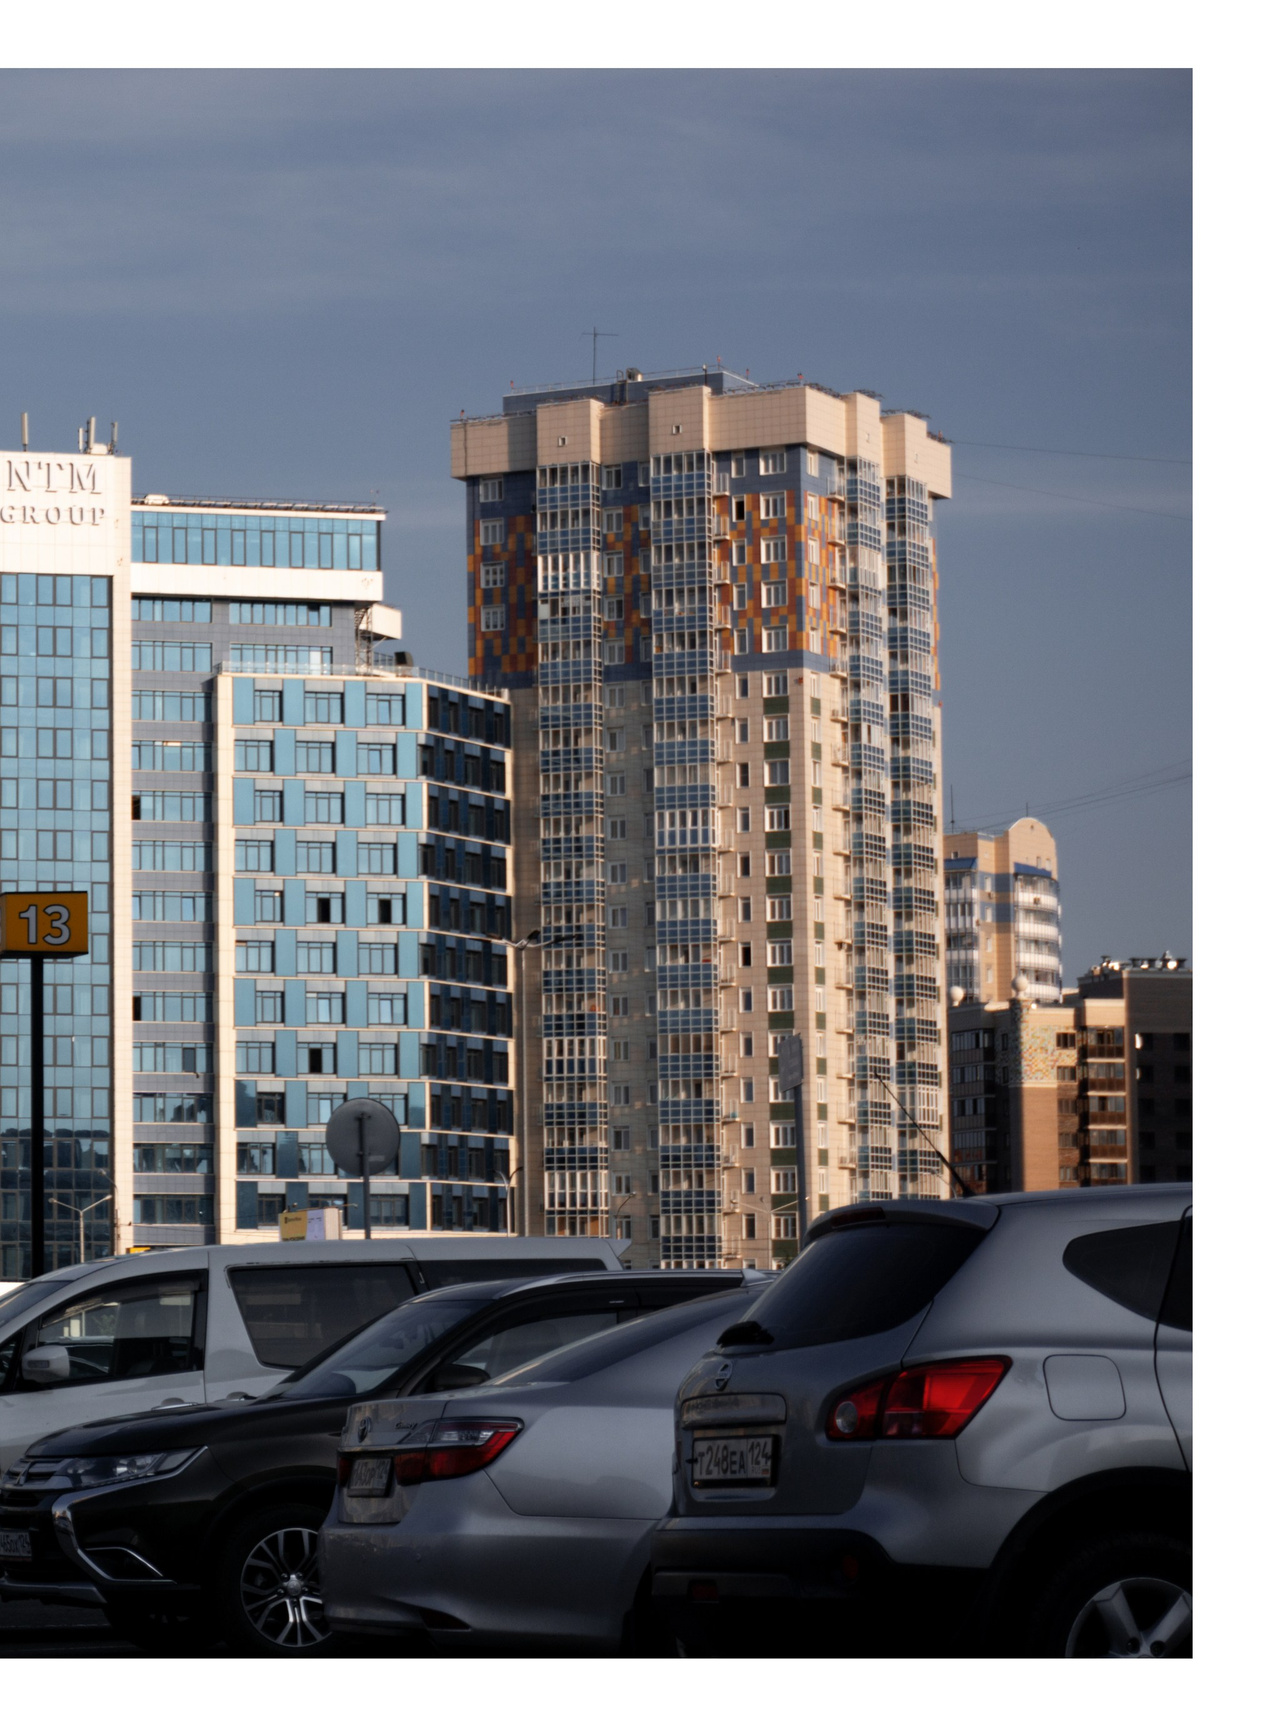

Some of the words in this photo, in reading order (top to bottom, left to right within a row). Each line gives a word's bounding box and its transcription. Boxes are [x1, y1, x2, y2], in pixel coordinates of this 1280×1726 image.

[6, 459, 102, 494] NTM
[0, 504, 105, 526] GROUP
[19, 904, 71, 946] 13
